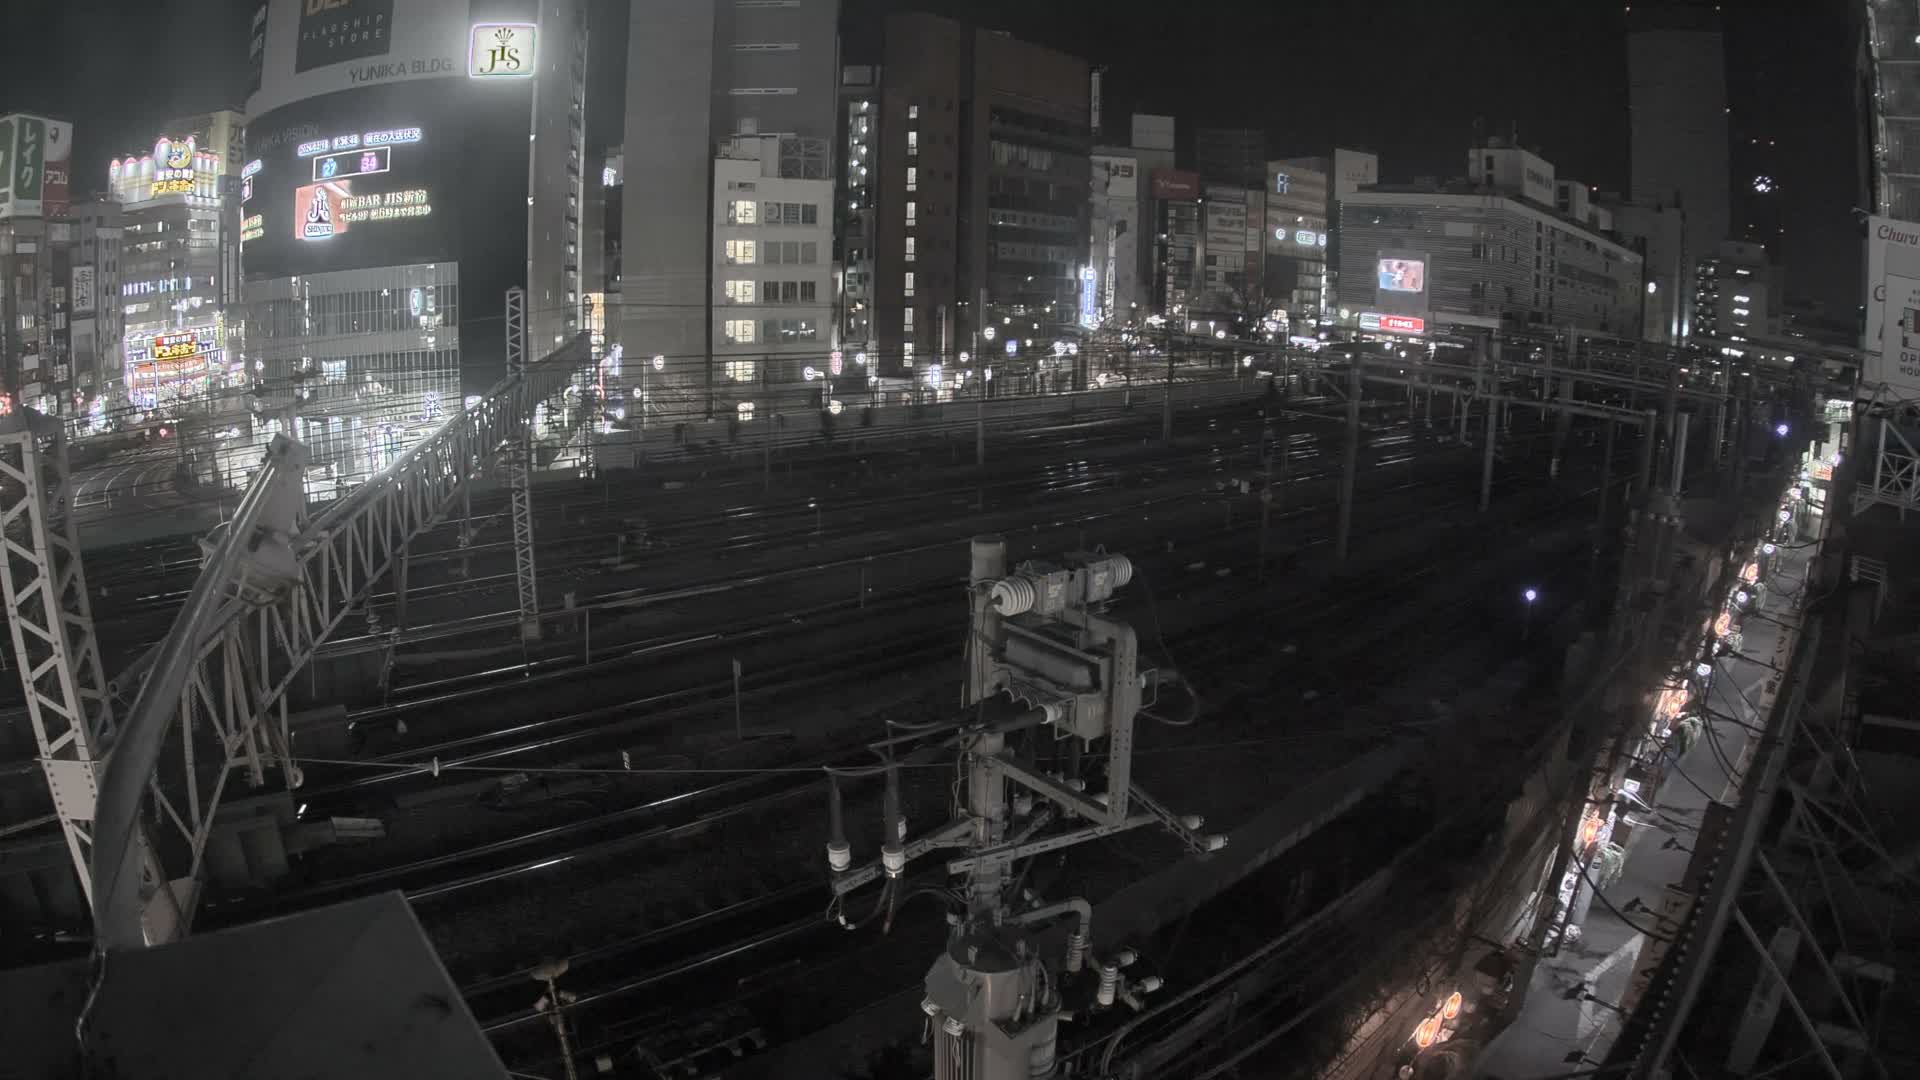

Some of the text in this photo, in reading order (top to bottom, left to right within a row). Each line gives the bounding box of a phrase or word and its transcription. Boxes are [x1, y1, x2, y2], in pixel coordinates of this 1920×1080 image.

[303, 14, 384, 41] FLAGSHIP
[328, 28, 382, 48] STORE
[480, 45, 521, 74] JIS
[349, 63, 407, 83] YUNIKA
[20, 121, 37, 189] レイク
[45, 169, 68, 185] アコム
[1900, 350, 1920, 364] OP
